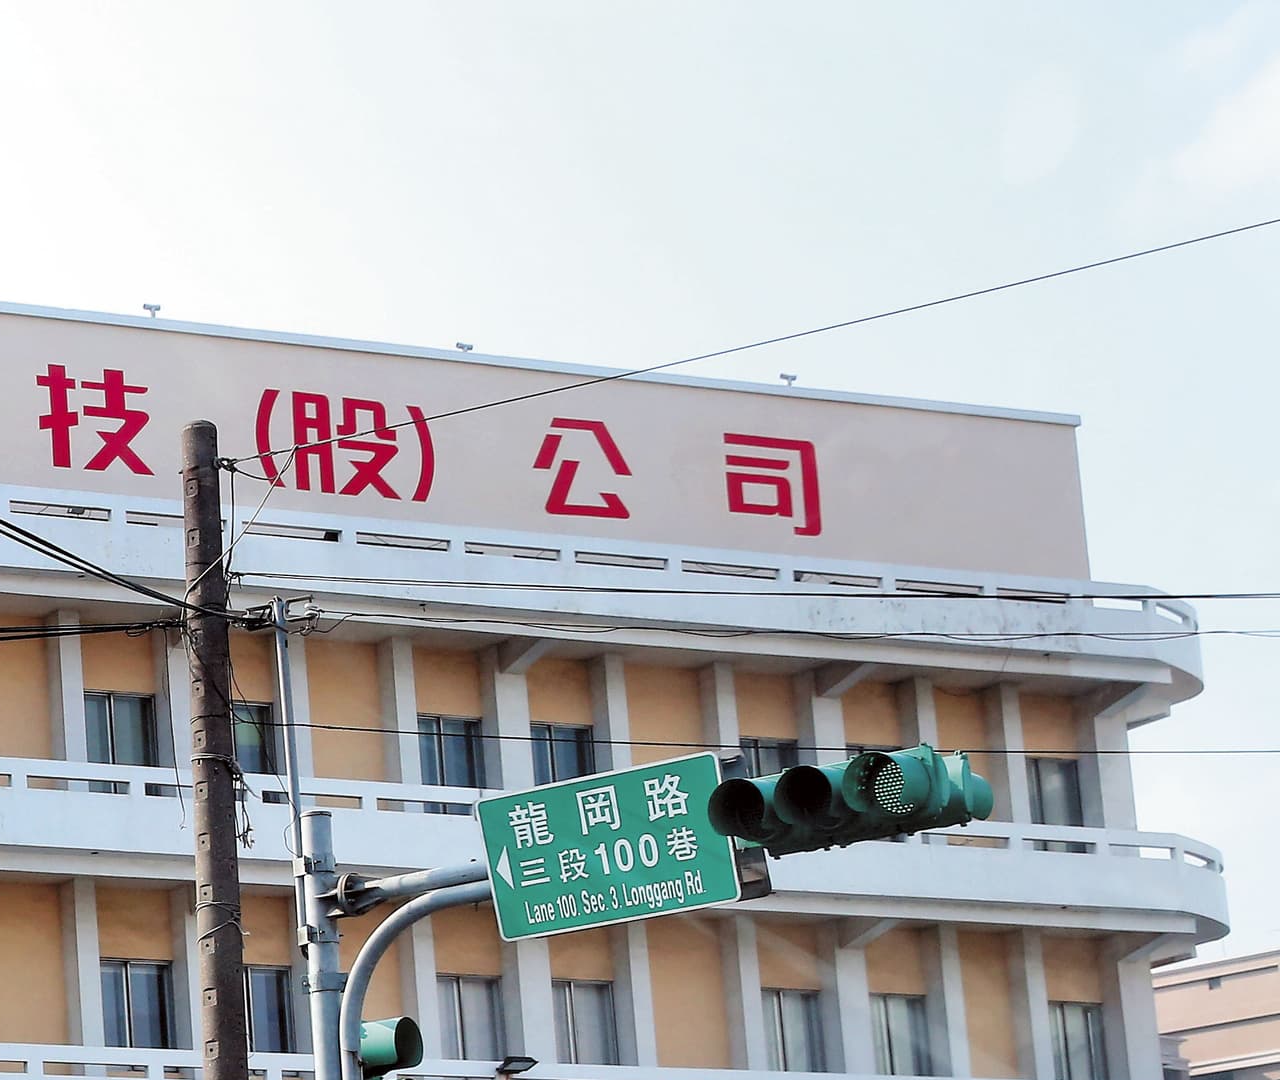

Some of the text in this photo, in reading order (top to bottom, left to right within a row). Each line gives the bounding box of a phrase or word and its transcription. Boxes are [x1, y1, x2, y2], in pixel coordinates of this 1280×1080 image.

[508, 774, 689, 849] 龍岡路
[519, 826, 699, 887] 三段100巷
[524, 901, 555, 924] Lane
[581, 890, 609, 917] Sec.
[622, 876, 685, 909] Longgang
[684, 869, 707, 895] Rd.
